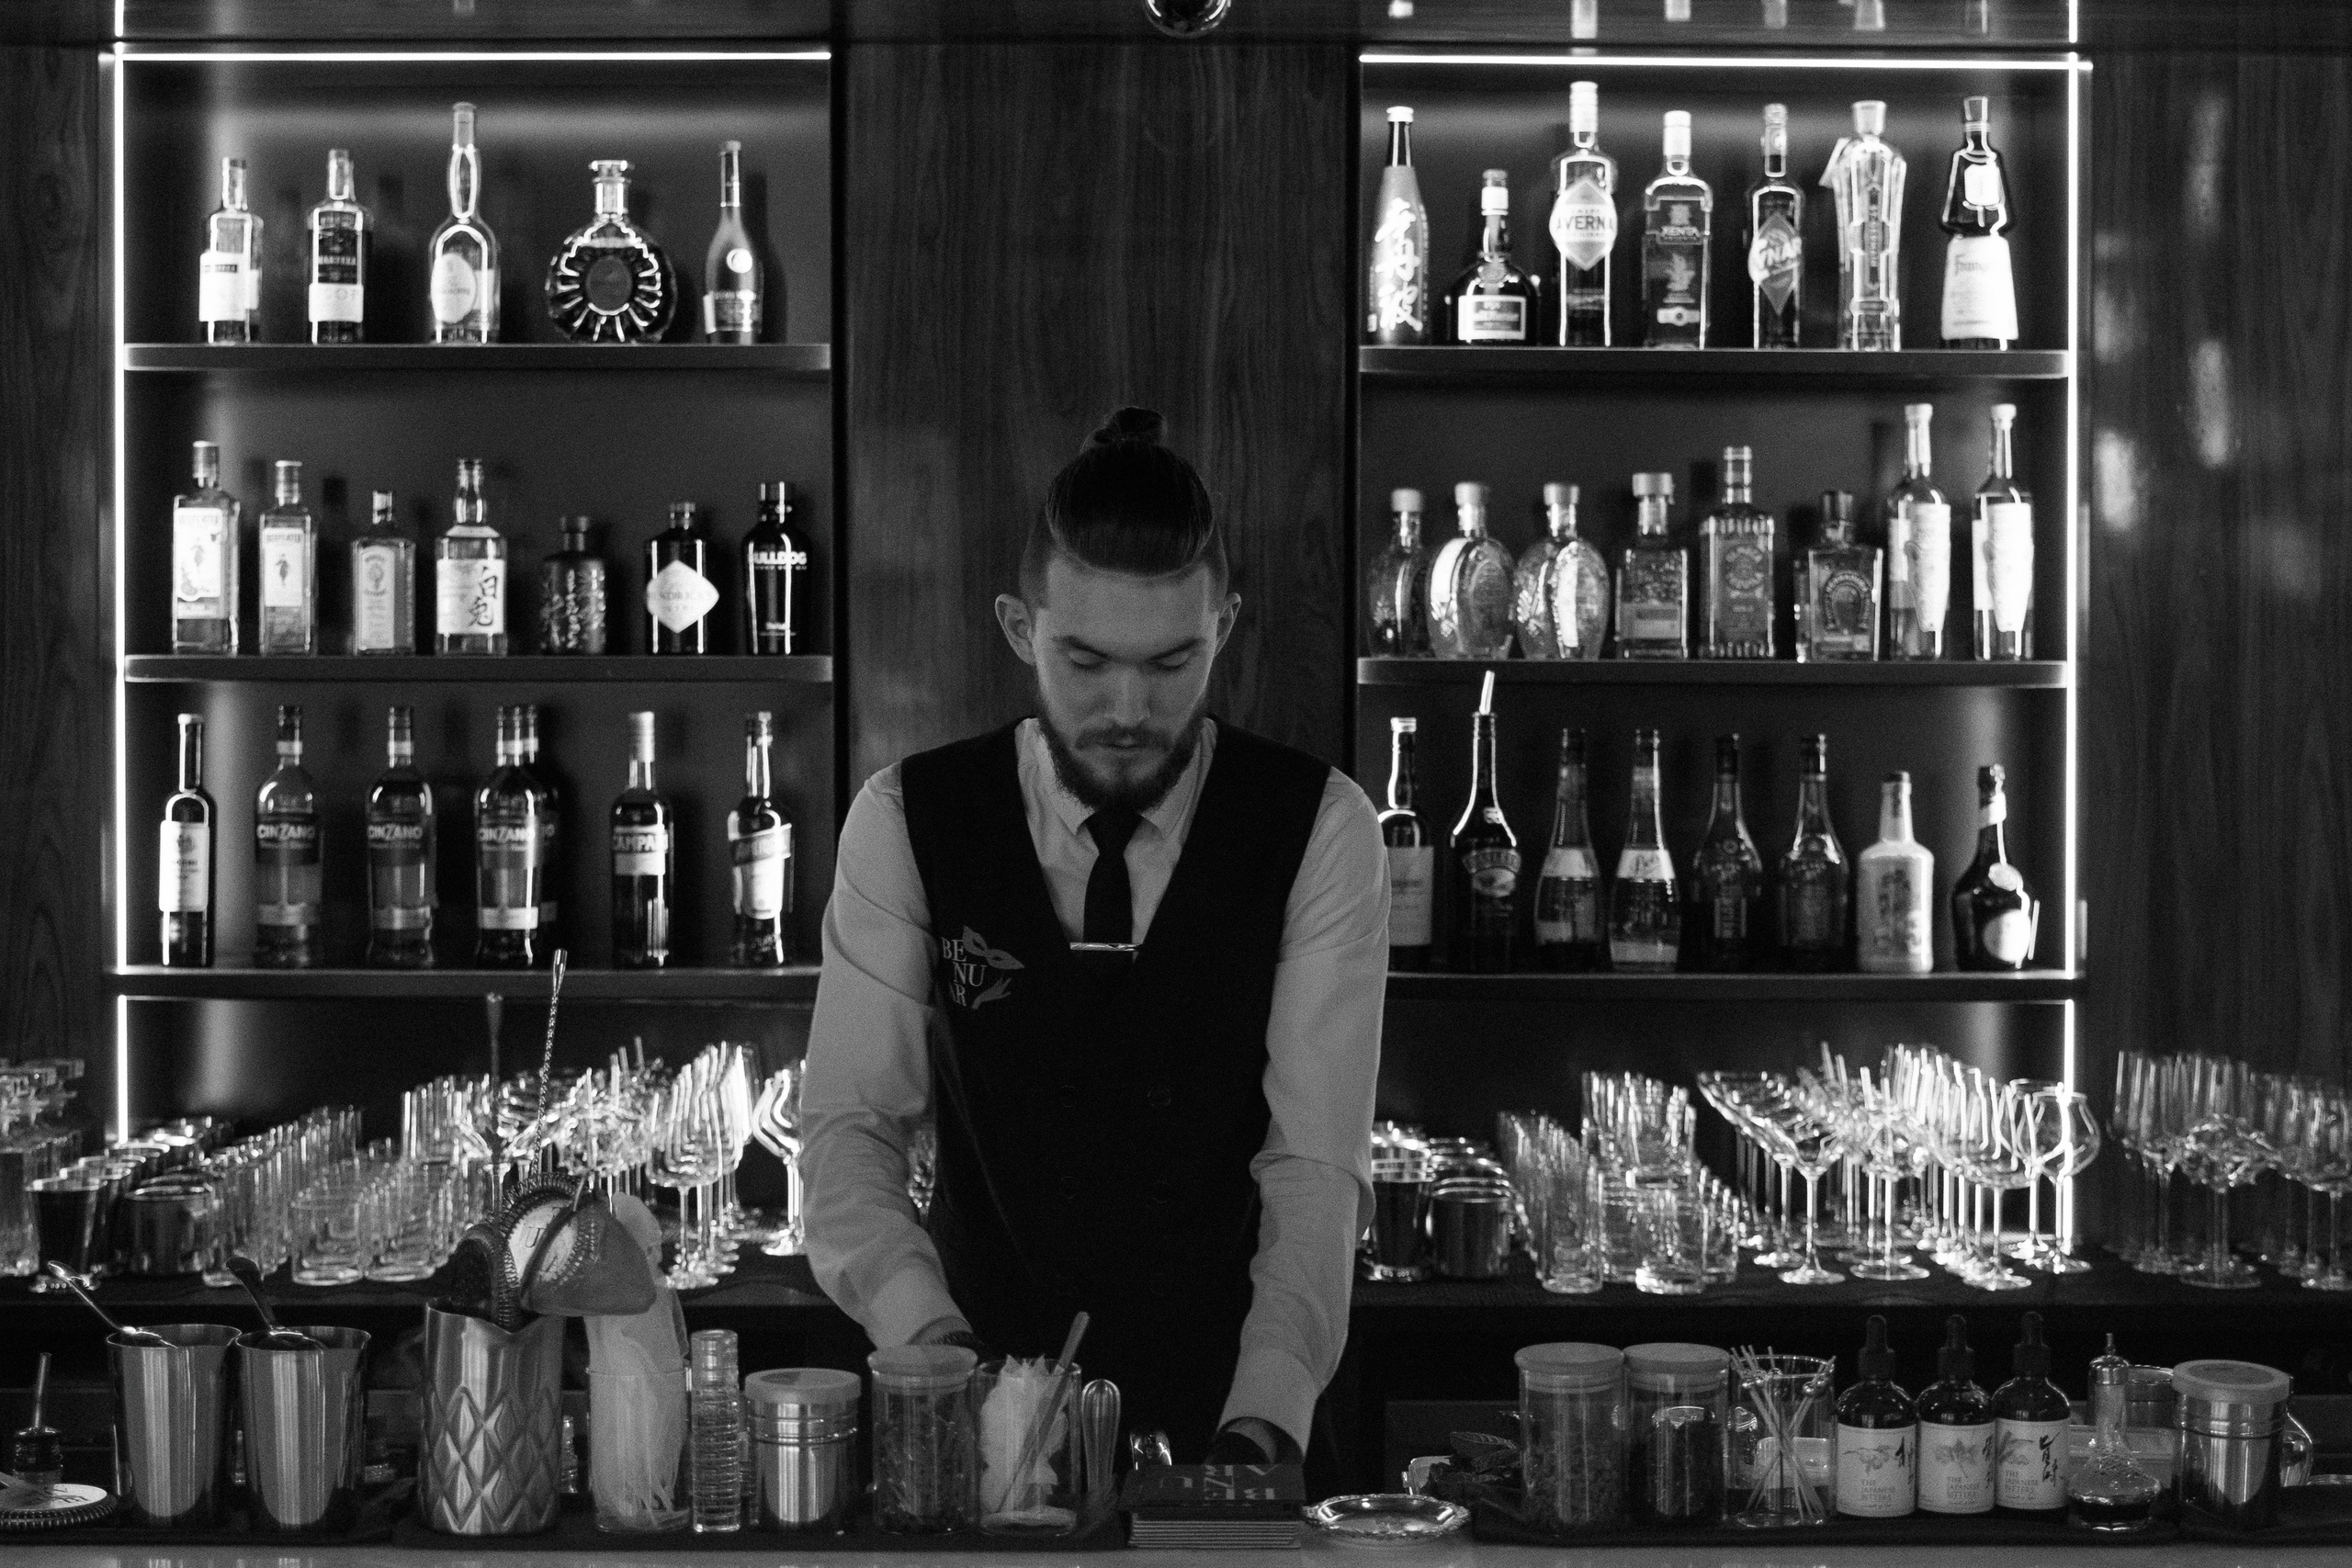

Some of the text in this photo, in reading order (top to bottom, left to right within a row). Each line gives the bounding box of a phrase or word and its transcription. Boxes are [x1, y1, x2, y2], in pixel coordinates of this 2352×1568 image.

[256, 823, 315, 840] CINZANO
[368, 823, 424, 840] CINZANO
[477, 825, 533, 843] CINZAN
[613, 832, 668, 852] CAMPA
[941, 936, 967, 963] BE
[952, 961, 988, 987] NU
